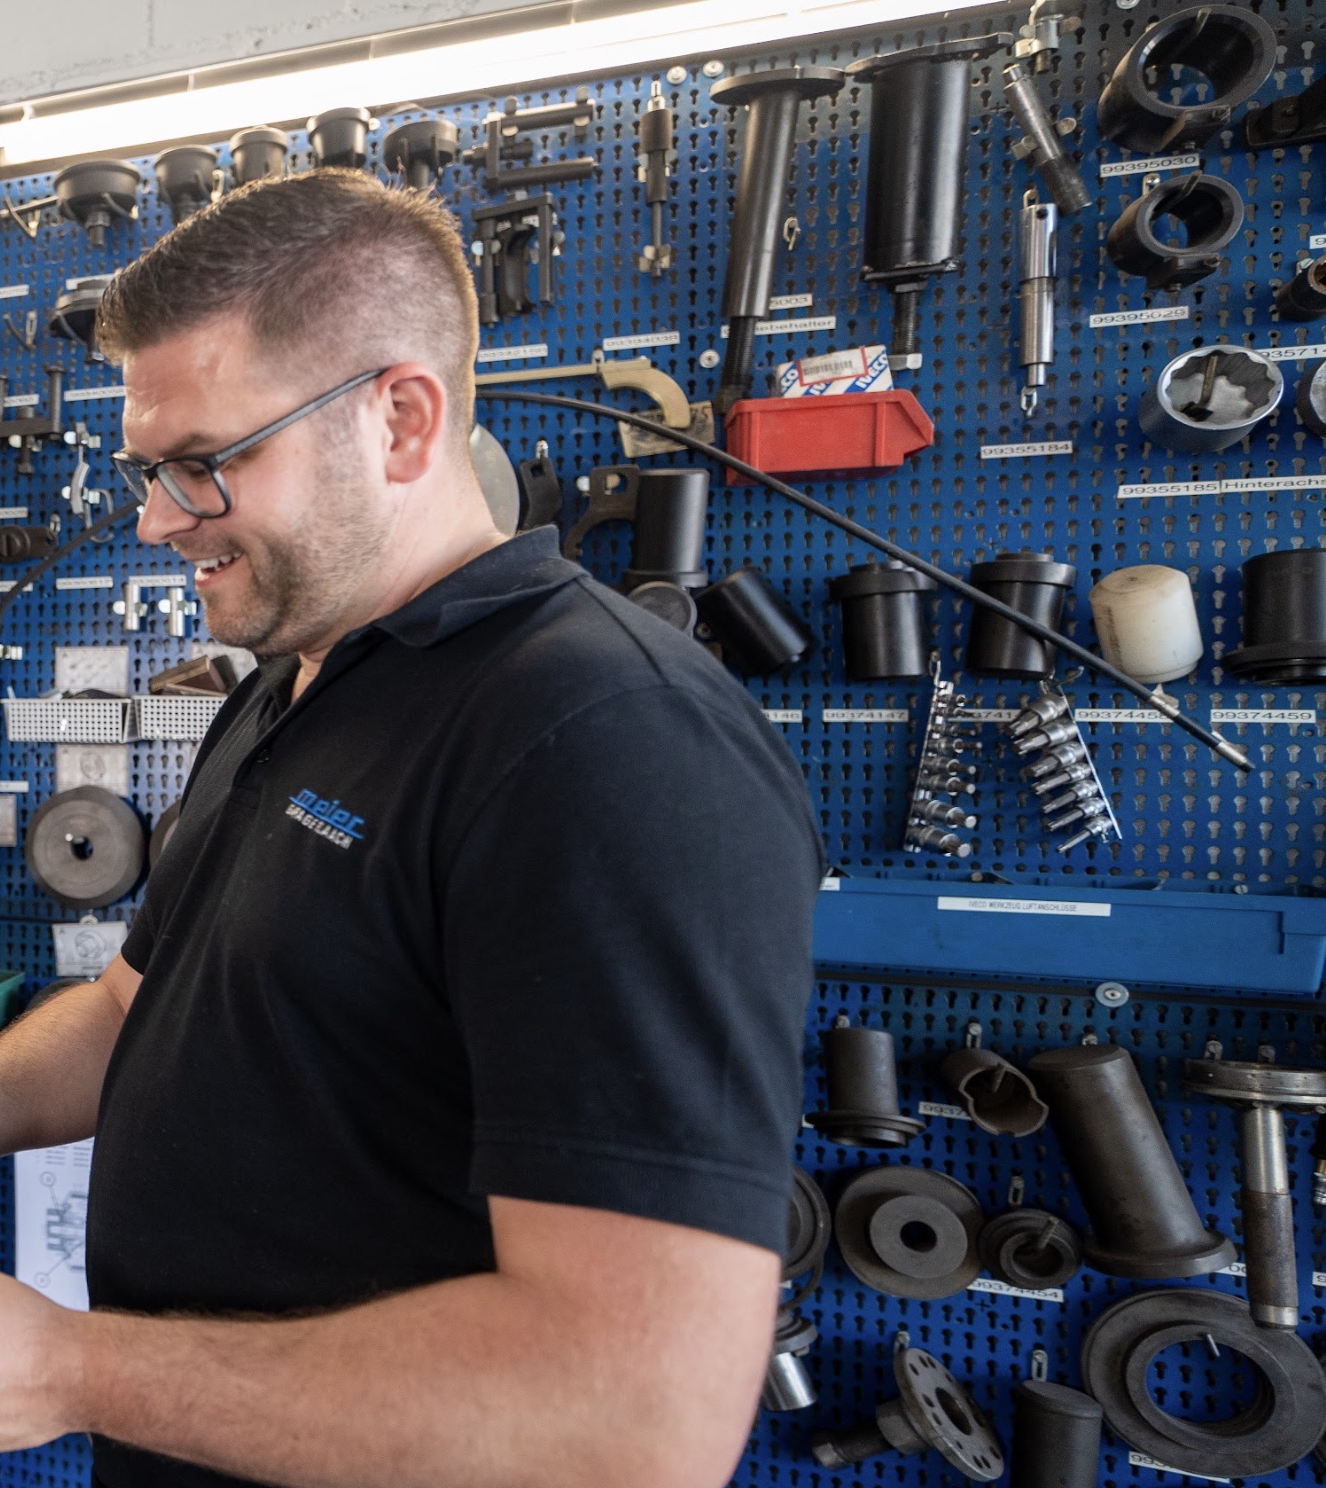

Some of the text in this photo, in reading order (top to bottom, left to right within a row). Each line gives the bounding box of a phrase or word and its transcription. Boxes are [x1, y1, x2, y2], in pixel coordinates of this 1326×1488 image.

[1102, 155, 1197, 174] 99395030
[1092, 307, 1187, 325] 99395029
[855, 353, 888, 389] IVECO
[981, 442, 1070, 456] 99355184
[1122, 482, 1217, 496] 99355185
[1212, 711, 1312, 721] 99374459
[290, 788, 364, 834] meier
